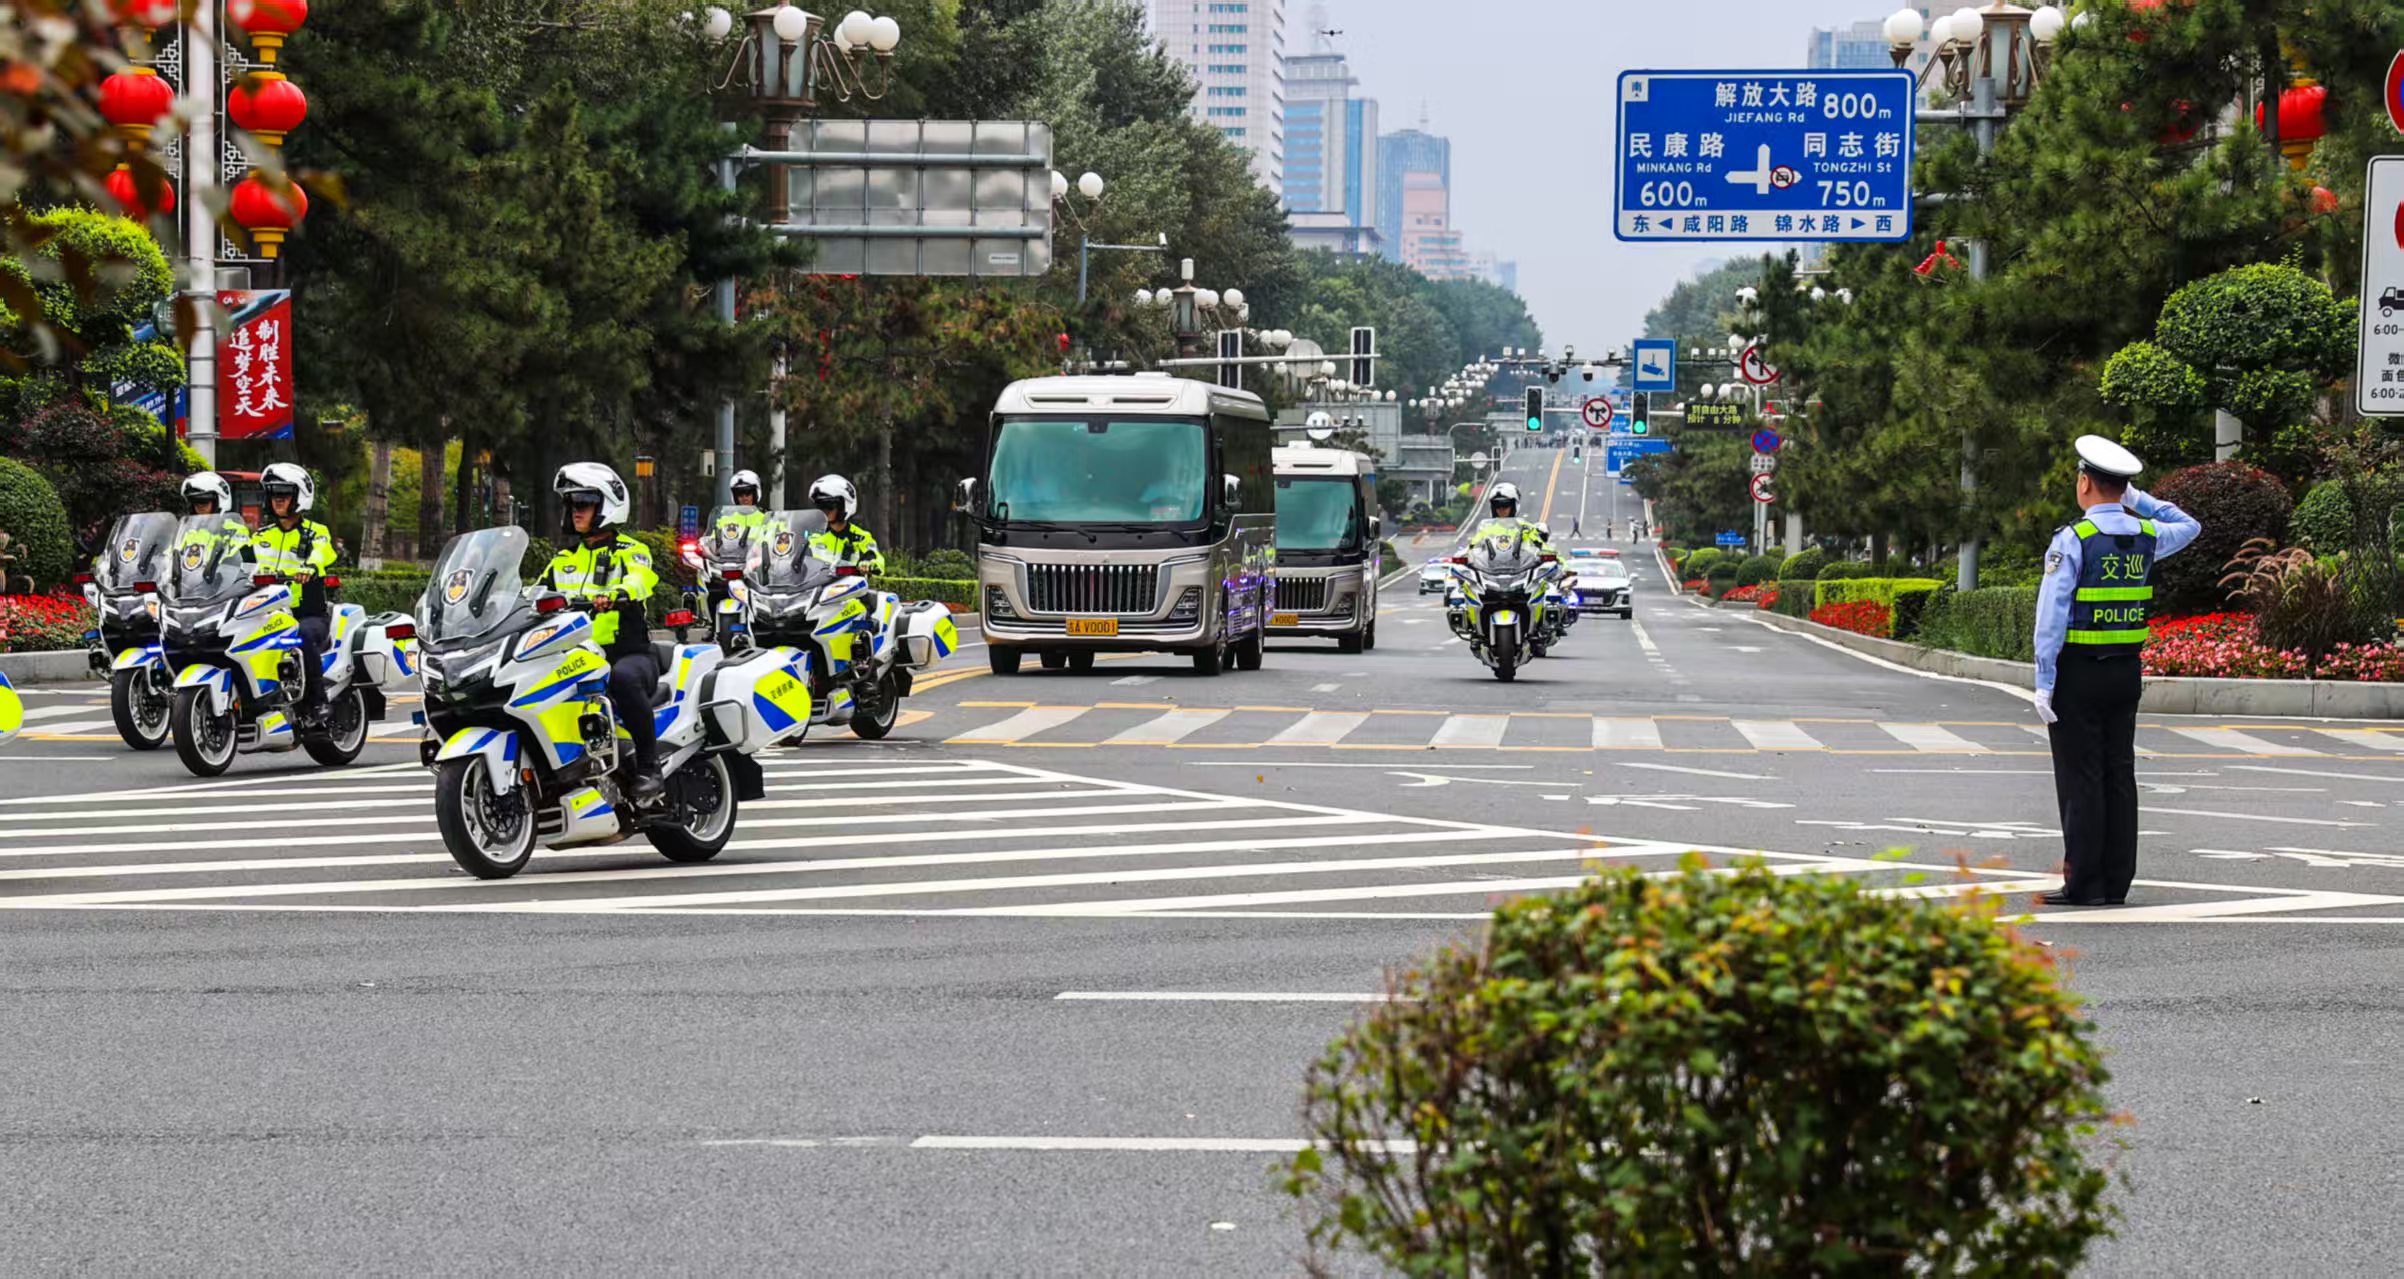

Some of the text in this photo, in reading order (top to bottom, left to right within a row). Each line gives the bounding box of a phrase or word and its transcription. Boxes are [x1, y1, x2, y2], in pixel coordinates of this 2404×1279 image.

[1714, 81, 1892, 120] 解放大路 800m
[1724, 112, 1805, 124] JIEFANG Rd
[1628, 132, 1726, 159] 民康路
[1803, 132, 1901, 158] 同志街
[1636, 162, 1712, 173] MINKANG Rd
[1813, 162, 1892, 173] TONGZHI St
[1640, 181, 1708, 207] 600m
[1816, 180, 1886, 207] 750m
[1632, 215, 1892, 234] 东 咸阳路 锦水路 西
[253, 319, 289, 411] 制胜未来
[2388, 352, 2404, 365] 微
[226, 327, 265, 418] 追梦空天
[2100, 553, 2144, 580] 交巡
[2093, 607, 2145, 623] POLICE
[556, 656, 587, 679] POLICE
